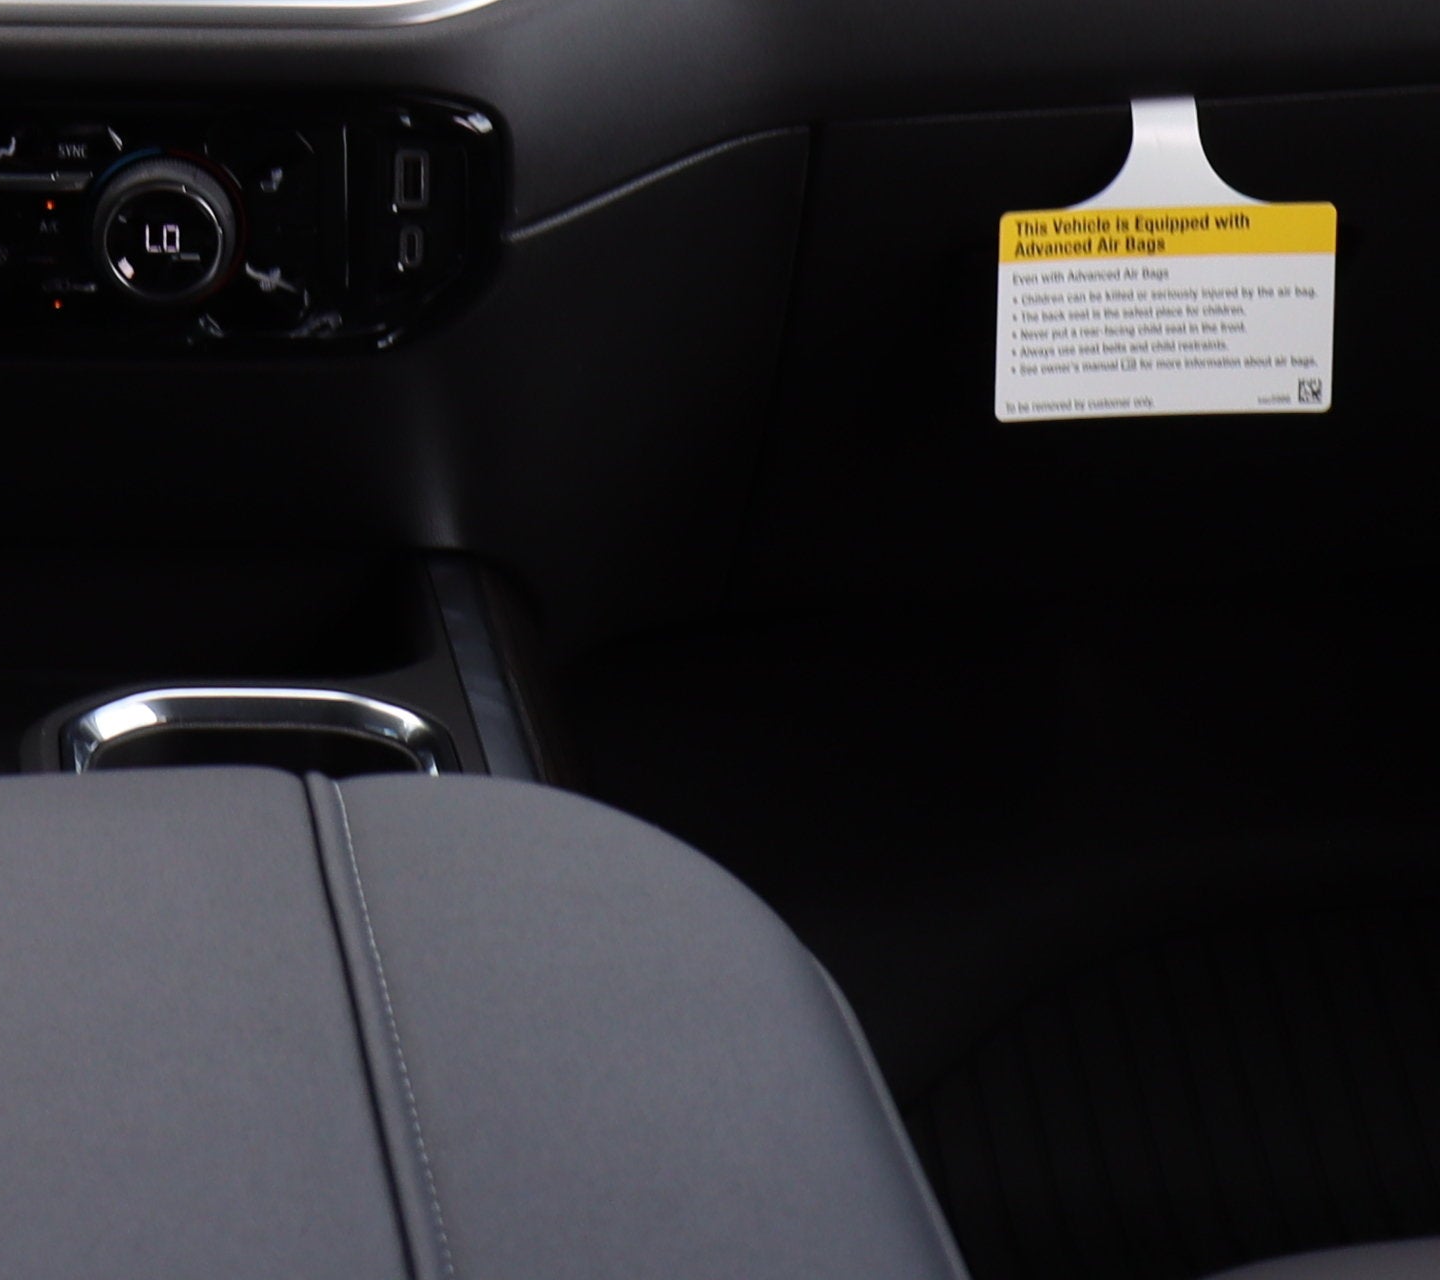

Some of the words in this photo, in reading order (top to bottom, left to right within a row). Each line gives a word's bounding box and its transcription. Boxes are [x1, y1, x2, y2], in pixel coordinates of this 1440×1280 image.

[58, 144, 88, 160] SYNC
[1016, 220, 1047, 237] This
[1053, 216, 1110, 235] Vehicle
[1116, 216, 1129, 233] is
[1135, 214, 1208, 235] Equipped
[1215, 213, 1250, 229] with
[1015, 237, 1092, 258] Advanced
[1097, 237, 1119, 254] Air
[1126, 236, 1165, 255] Bags
[1012, 271, 1038, 286] Even
[1041, 269, 1064, 284] with
[1067, 267, 1120, 283] Advanced
[1123, 267, 1138, 281] Air
[1142, 266, 1169, 282] Bags
